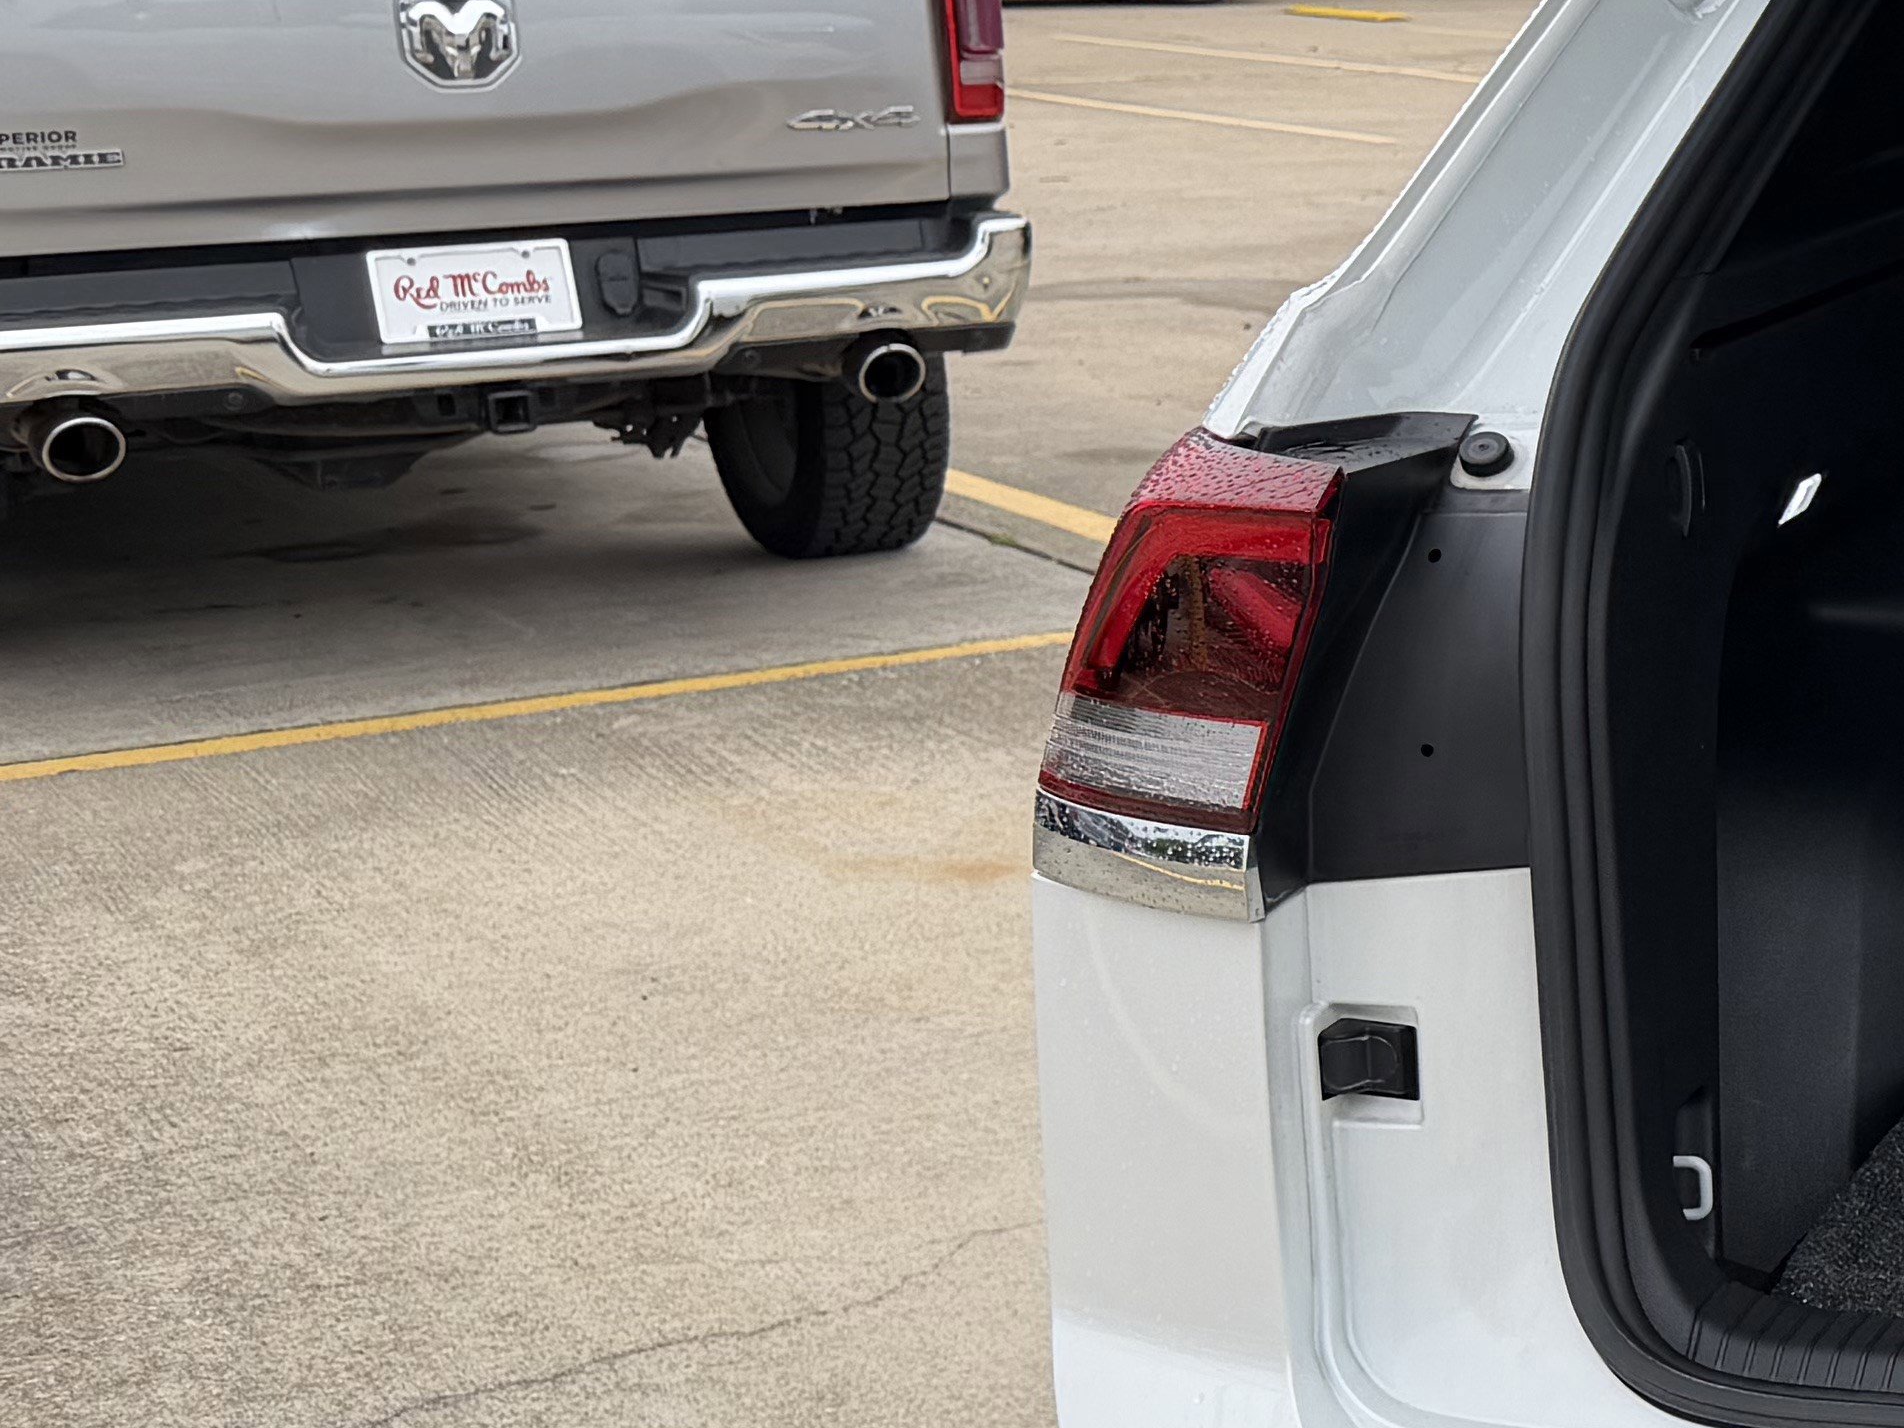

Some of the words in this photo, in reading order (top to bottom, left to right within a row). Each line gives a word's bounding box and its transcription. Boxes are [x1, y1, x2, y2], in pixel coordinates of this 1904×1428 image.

[0, 130, 77, 146] PERIOR
[393, 274, 440, 310] Red
[439, 297, 489, 313] DRIVEN
[492, 297, 511, 308] TO
[513, 293, 552, 306] SERVE
